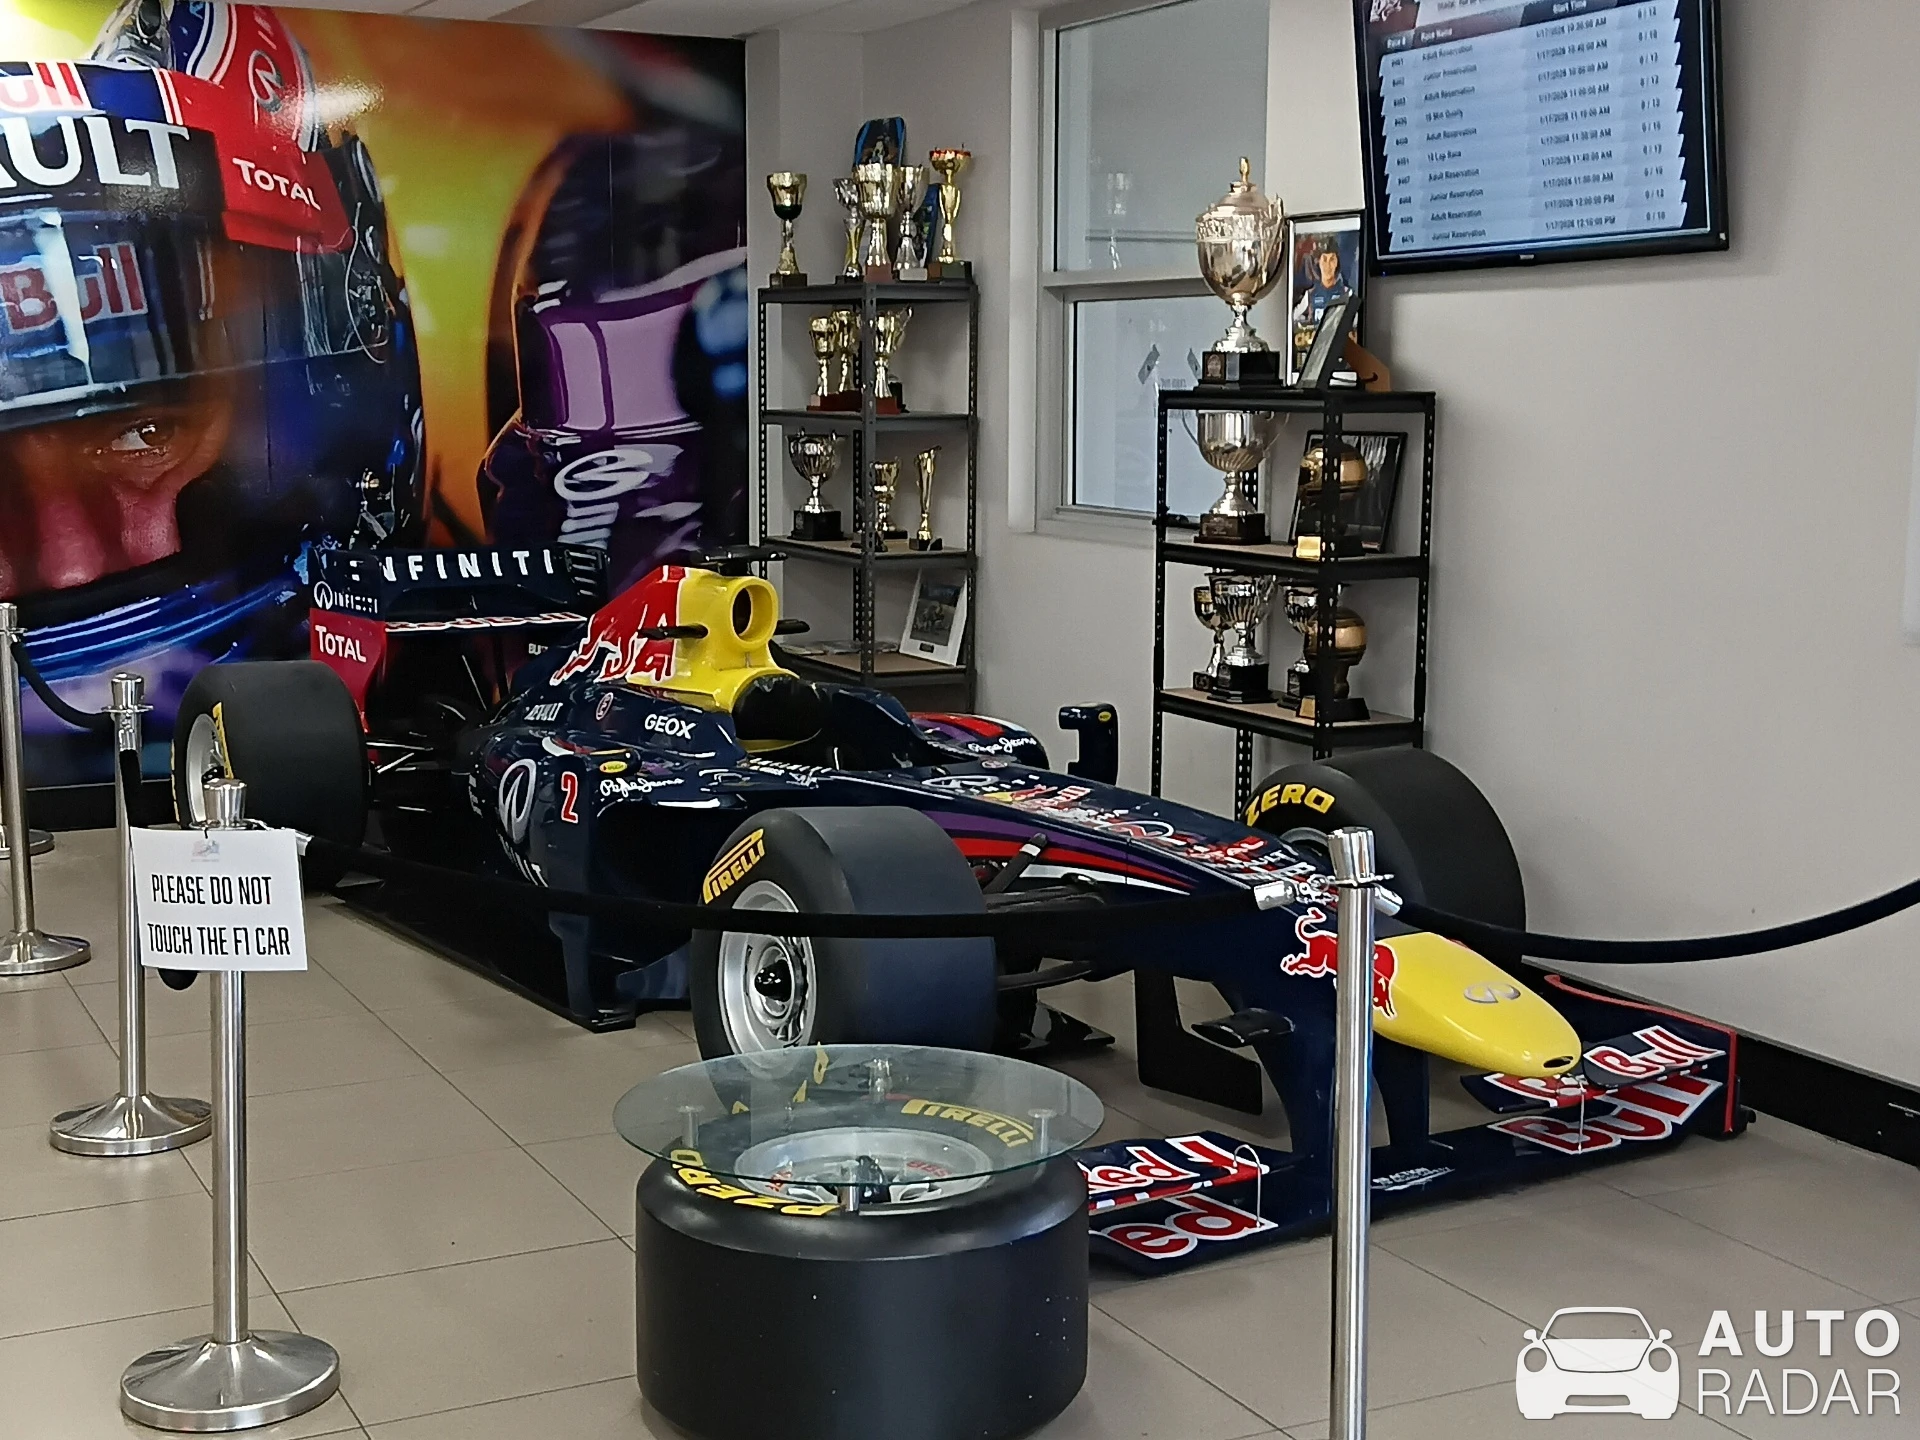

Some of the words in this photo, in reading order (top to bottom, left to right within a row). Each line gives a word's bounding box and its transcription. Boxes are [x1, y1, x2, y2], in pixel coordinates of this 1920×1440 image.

[0, 115, 190, 189] ULT
[232, 157, 321, 211] TOTAL
[381, 549, 554, 582] NFINITI
[315, 624, 367, 663] TOTAL
[644, 713, 696, 740] GEOX
[560, 770, 579, 824] 2
[1244, 783, 1335, 827] ZERO
[151, 873, 206, 905] PLEASE
[209, 876, 233, 905] DO
[238, 876, 272, 905] NOT
[702, 828, 765, 904] PIRELLI
[147, 923, 193, 955] TOUCH
[197, 926, 229, 956] THE
[233, 926, 250, 956] F1
[255, 926, 291, 956] CAR
[1583, 1025, 1726, 1079] Bull
[901, 1098, 1034, 1148] PIRELLI
[1487, 1072, 1723, 1155] Bull
[1077, 1146, 1201, 1195] ed
[1088, 1192, 1279, 1259] ed
